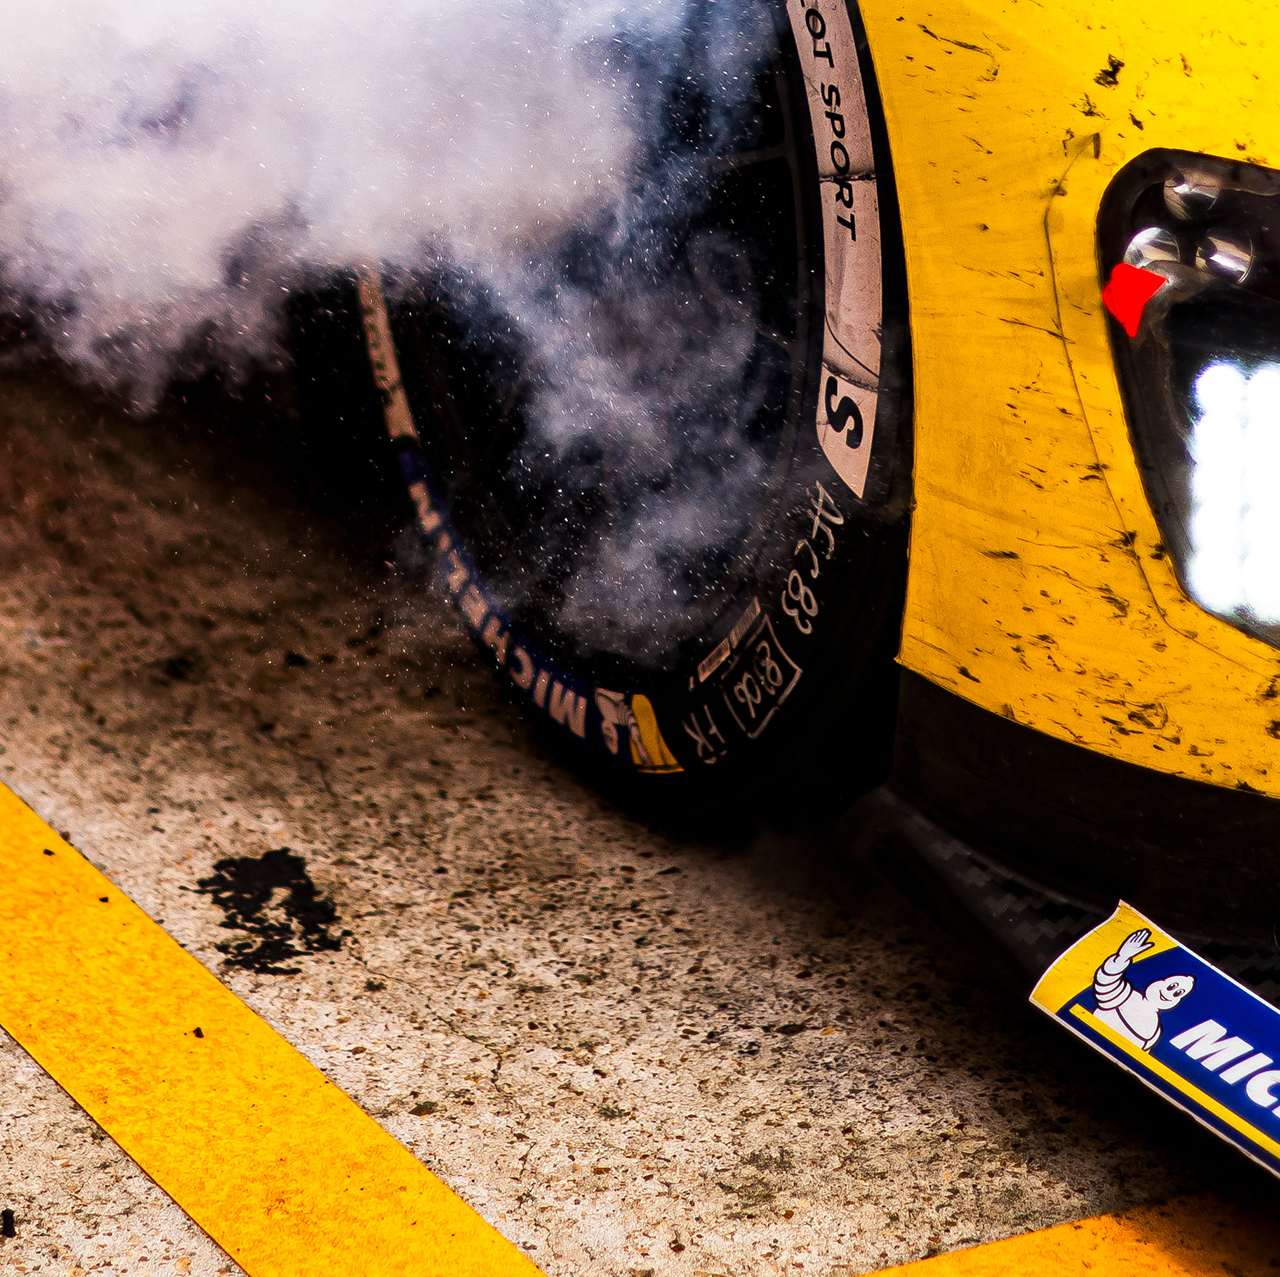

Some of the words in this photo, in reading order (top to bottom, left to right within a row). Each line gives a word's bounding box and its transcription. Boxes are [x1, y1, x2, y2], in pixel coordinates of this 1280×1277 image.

[820, 80, 858, 242] SPORT
[825, 375, 864, 450] S
[408, 480, 588, 740] MICHELIN
